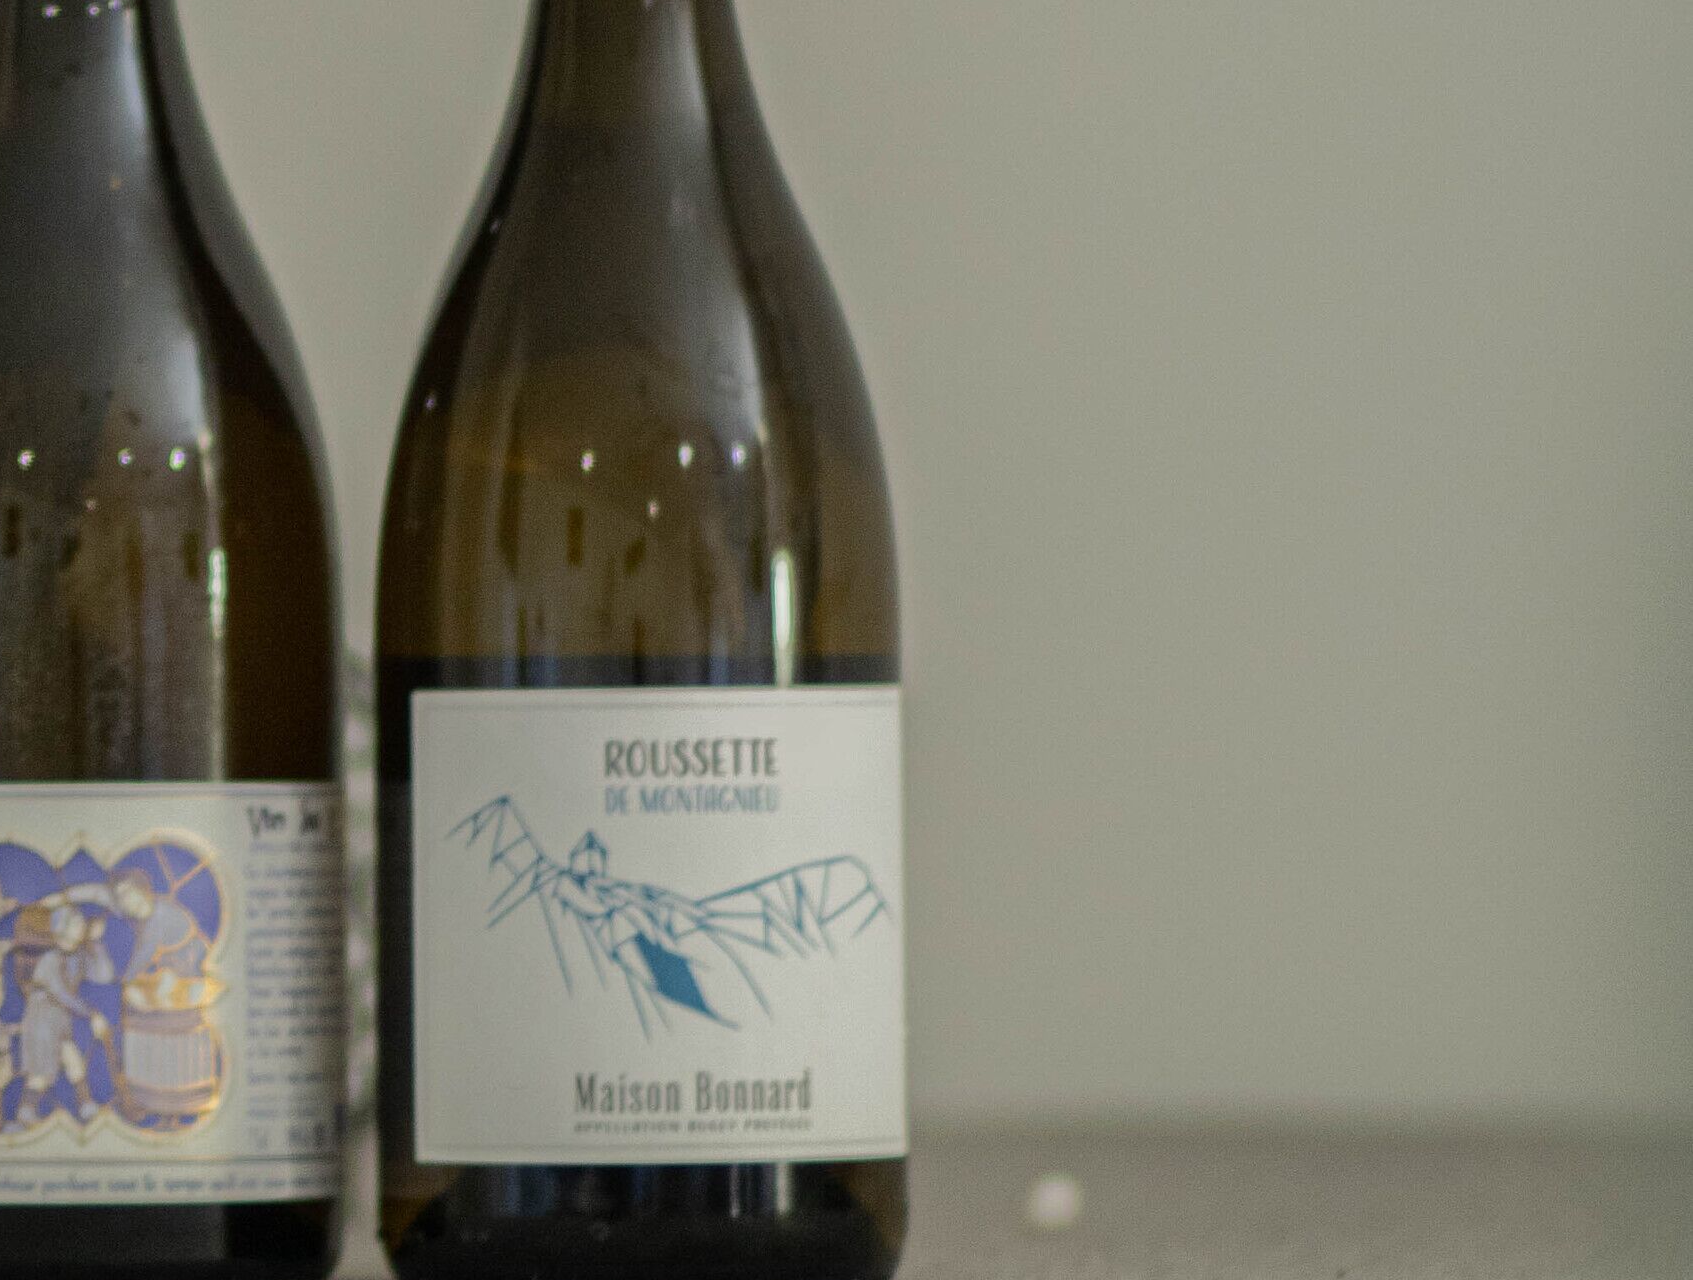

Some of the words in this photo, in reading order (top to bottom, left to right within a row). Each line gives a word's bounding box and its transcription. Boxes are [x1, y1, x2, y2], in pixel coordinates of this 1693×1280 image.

[604, 738, 778, 777] ROUSSETTE
[605, 786, 628, 813] DE
[574, 1073, 681, 1113] Maison
[695, 1068, 811, 1112] Bonnard
